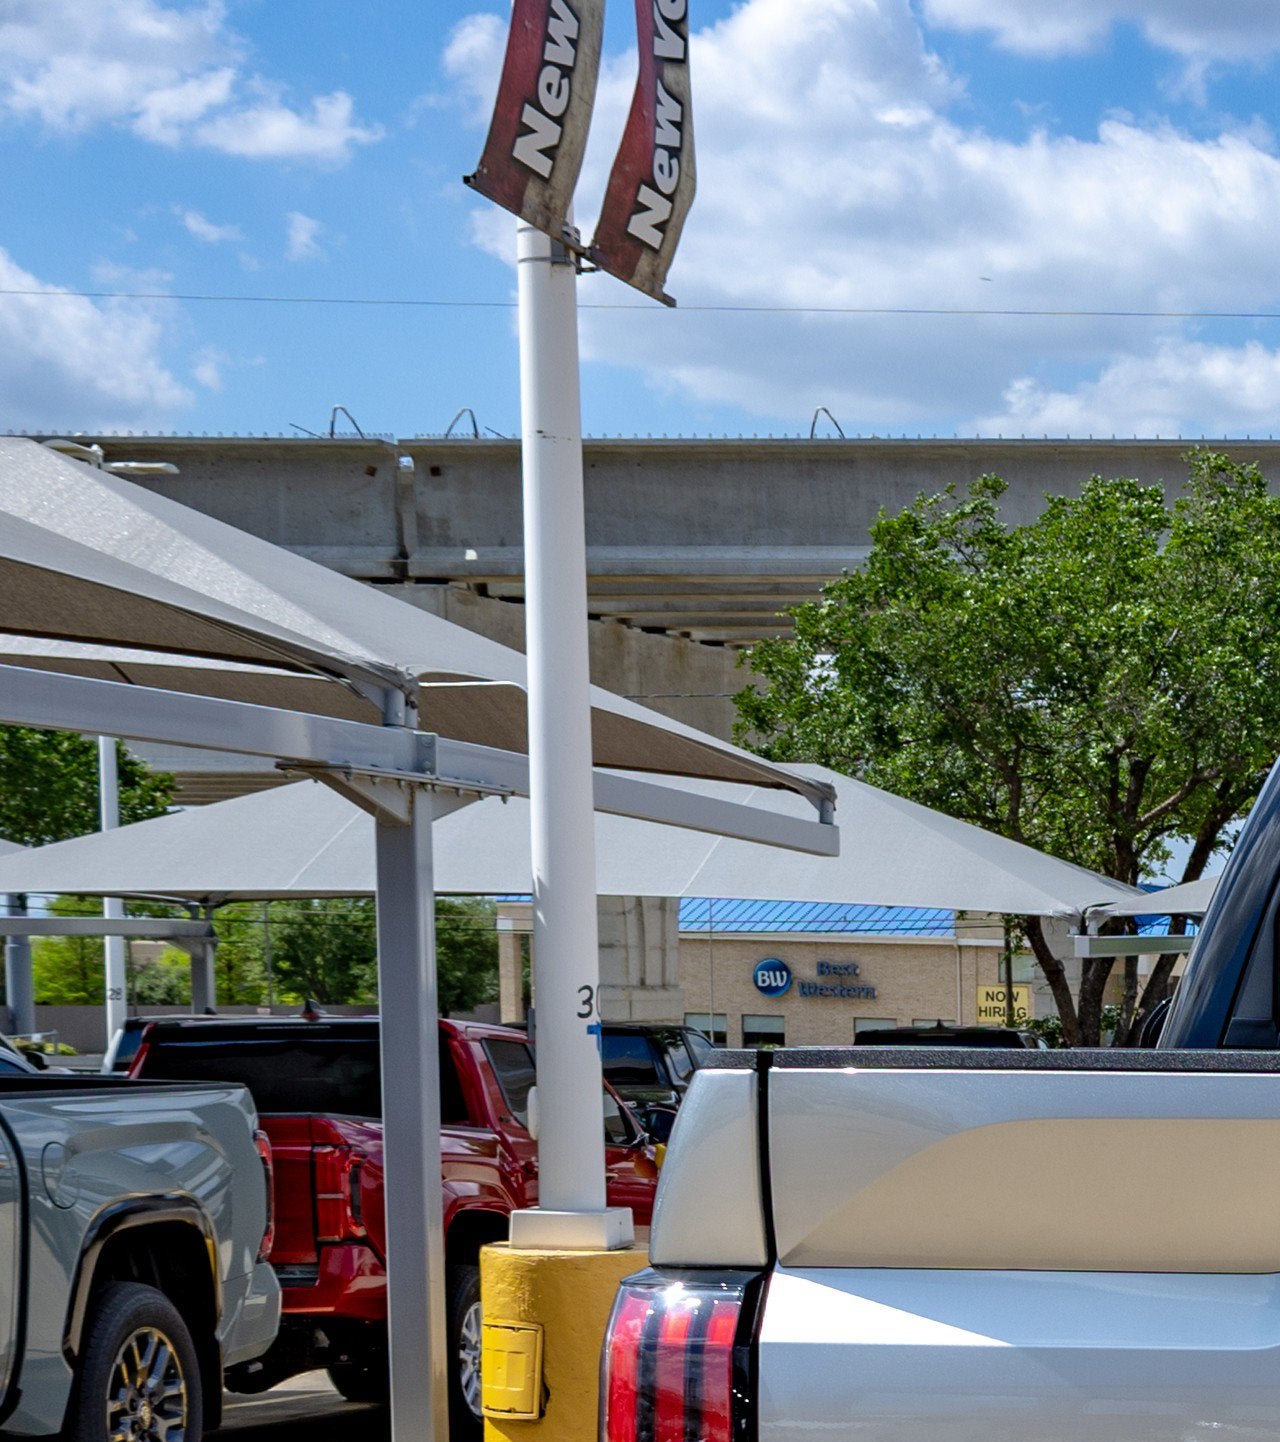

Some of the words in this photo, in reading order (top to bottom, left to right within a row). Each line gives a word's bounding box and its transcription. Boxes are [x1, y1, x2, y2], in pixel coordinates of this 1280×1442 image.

[512, 0, 579, 178] New
[627, 78, 684, 249] New
[816, 960, 860, 977] Best
[757, 970, 788, 987] BW
[798, 981, 877, 999] Western
[978, 1006, 1027, 1018] HIRIG
